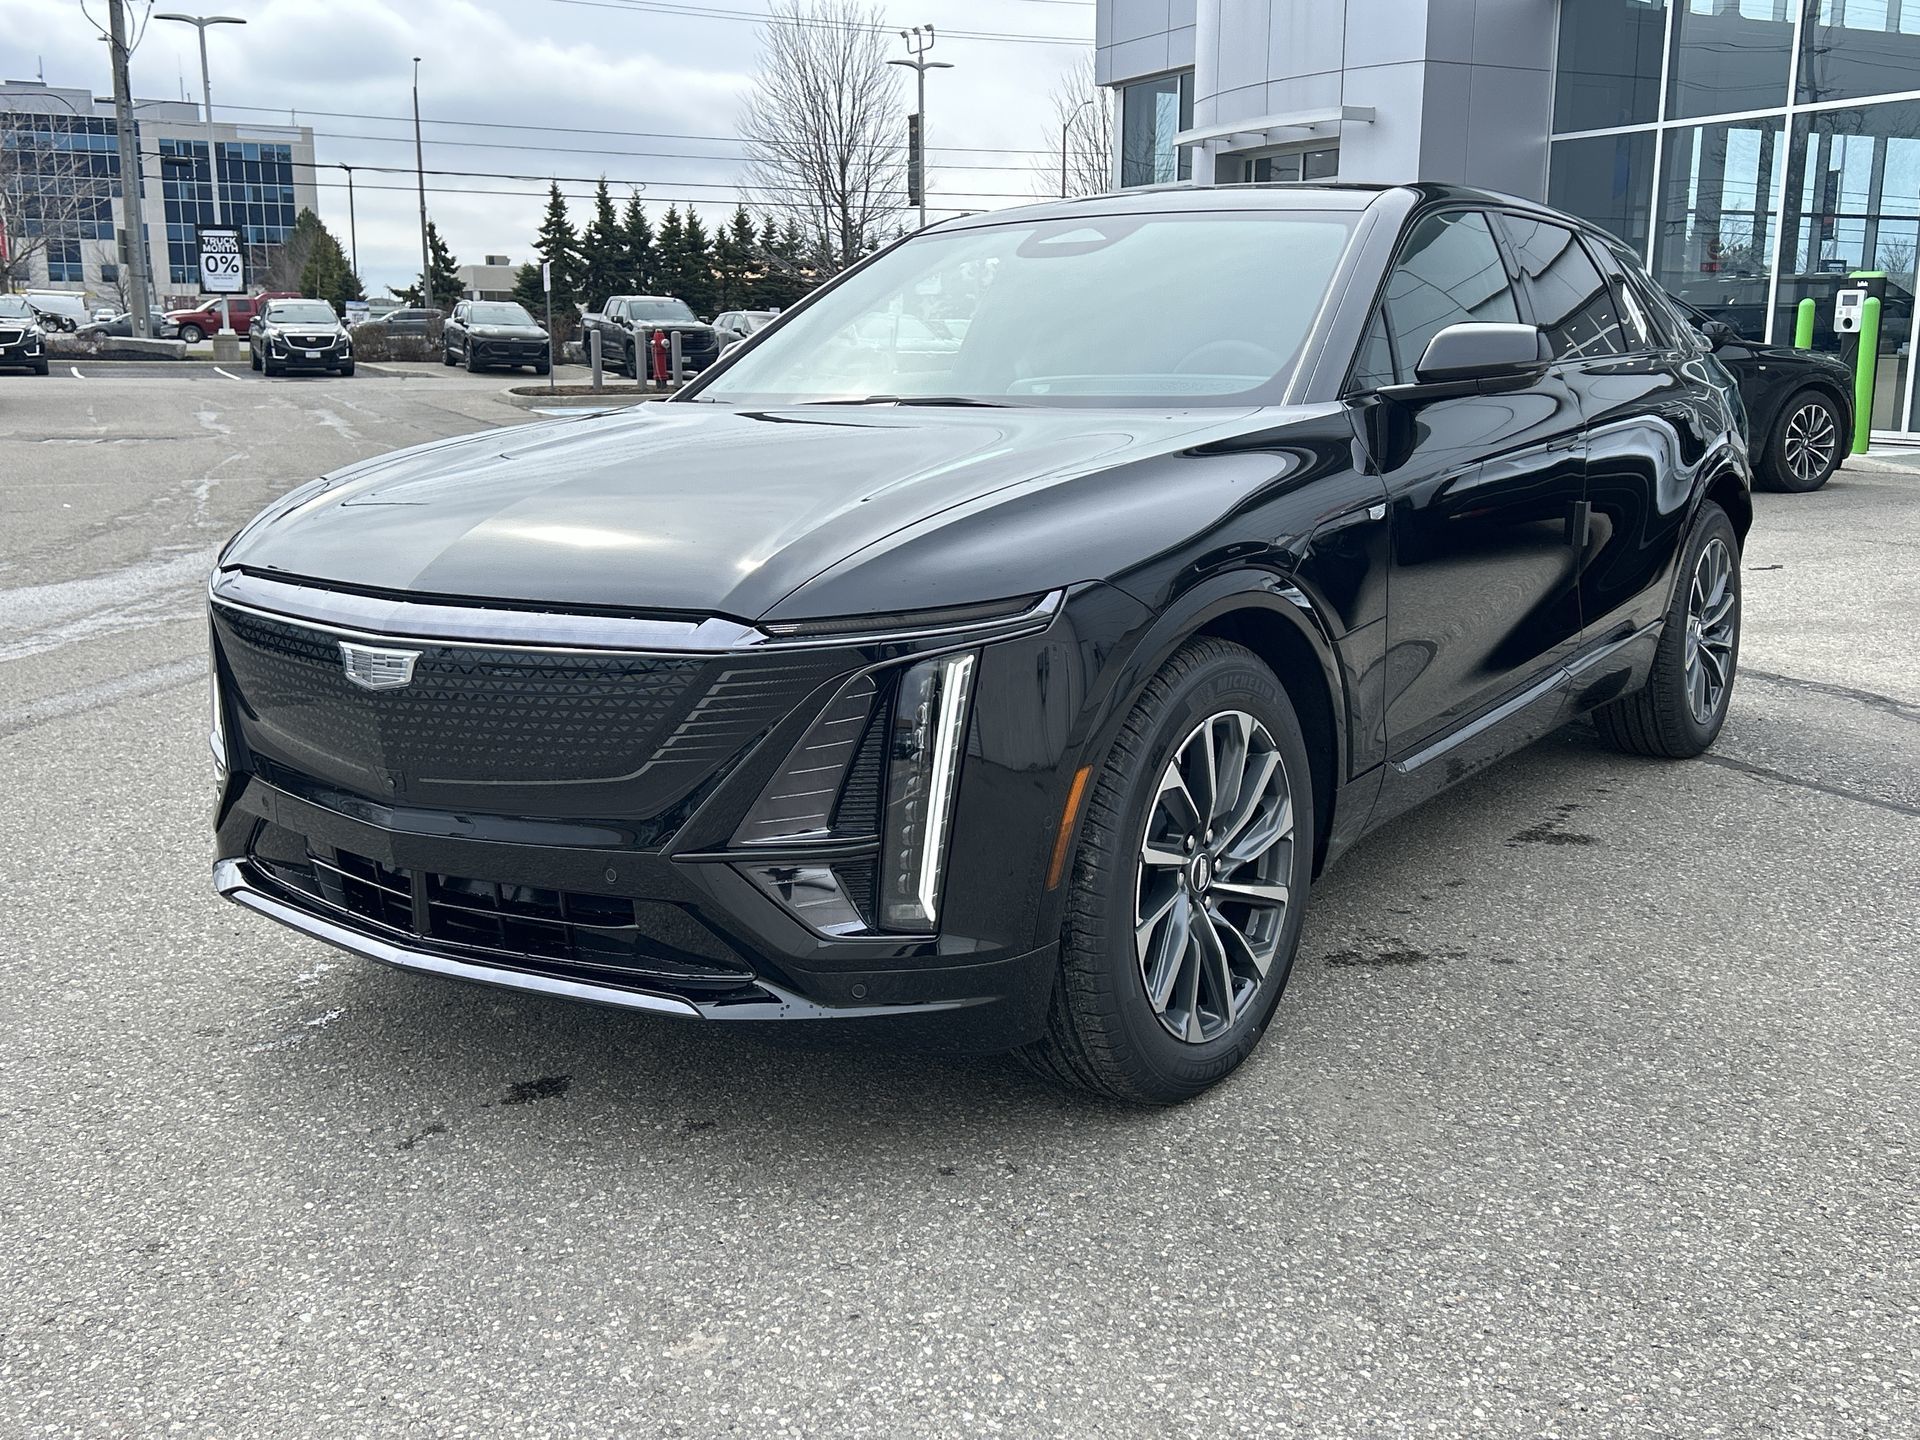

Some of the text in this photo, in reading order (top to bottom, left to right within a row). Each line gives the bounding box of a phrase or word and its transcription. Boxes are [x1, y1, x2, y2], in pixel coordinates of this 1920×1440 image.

[203, 237, 236, 245] TRUCK
[203, 244, 239, 253] MONTH
[205, 255, 239, 273] 0%
[1217, 674, 1273, 700] MICHELIN
